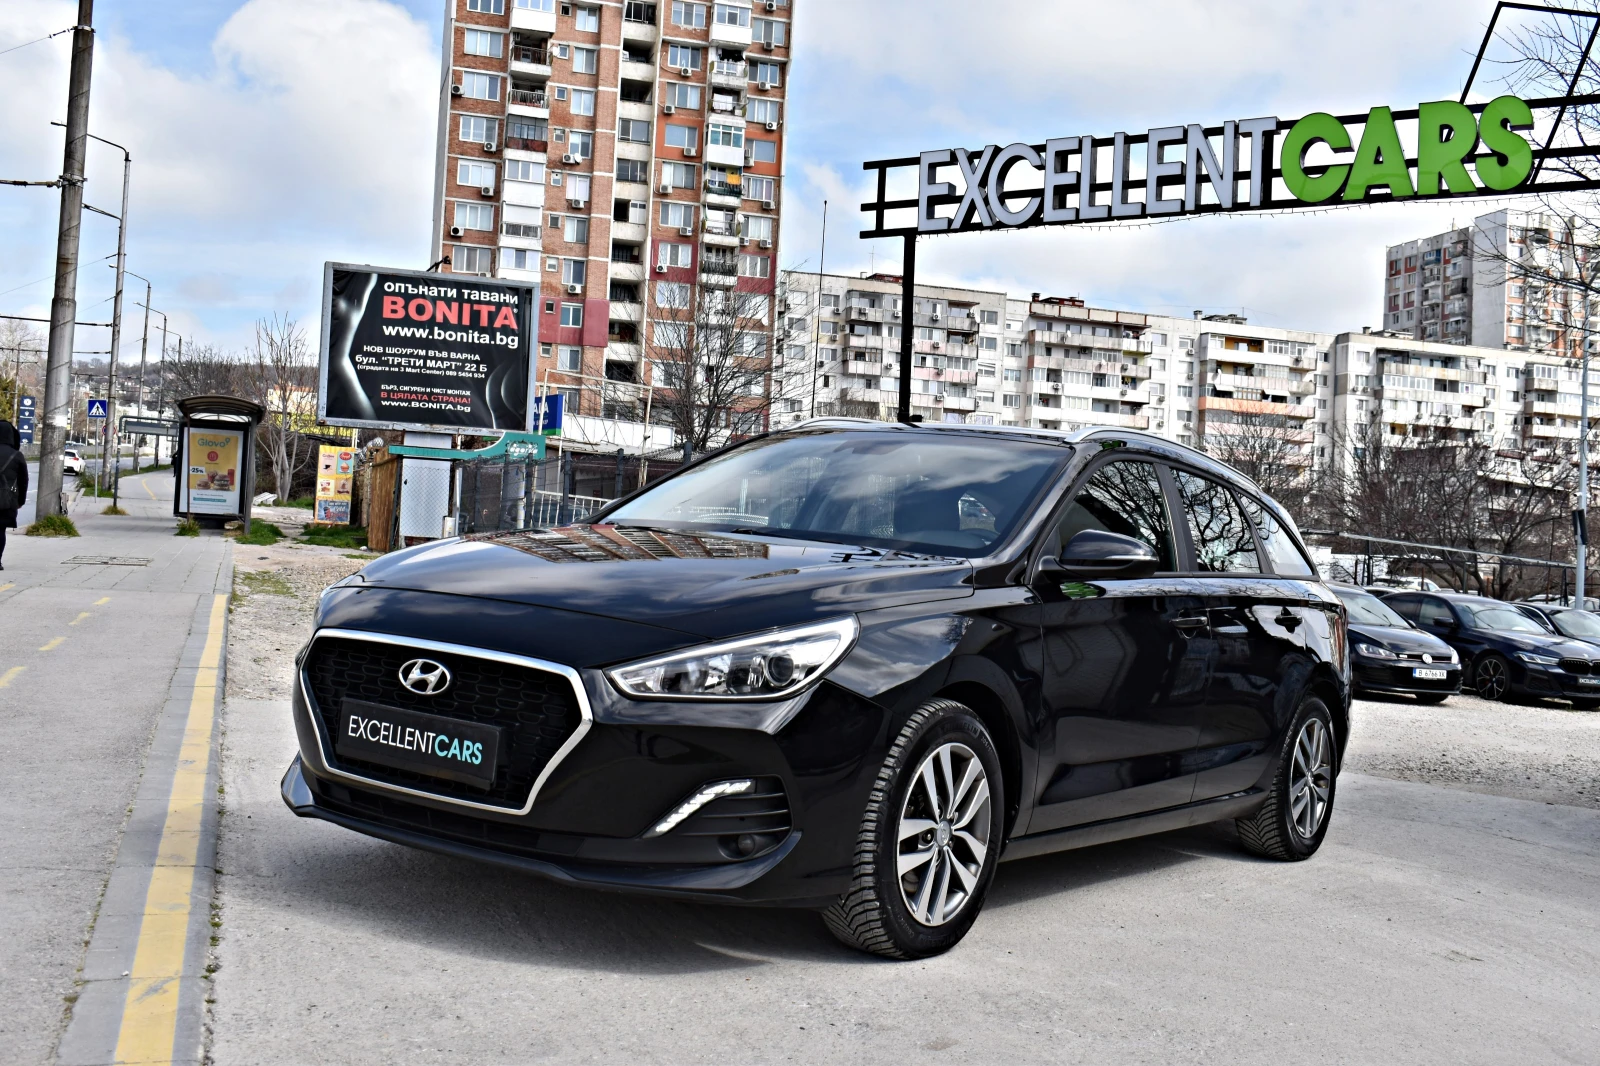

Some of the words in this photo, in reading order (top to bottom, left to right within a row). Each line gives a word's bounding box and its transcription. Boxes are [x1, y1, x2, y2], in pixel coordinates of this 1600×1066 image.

[384, 282, 456, 298] опънати
[462, 289, 518, 304] тавани
[383, 296, 518, 329] BONITA
[383, 325, 518, 348] www.bonita.bg
[364, 345, 383, 353] НОВ
[386, 347, 426, 356] ШОУРУМ
[428, 350, 448, 358] ВЪВ
[450, 352, 480, 360] ВАРНА
[356, 354, 378, 364] бул.
[465, 363, 476, 371] 22
[480, 364, 487, 372] Б
[381, 401, 471, 412] www.BONITA.bg
[390, 392, 428, 400] ЦЯЛАТА
[431, 395, 471, 404] СТРАНА!
[198, 438, 227, 448] Glovo
[348, 715, 483, 765] EXCELLENTCARS
